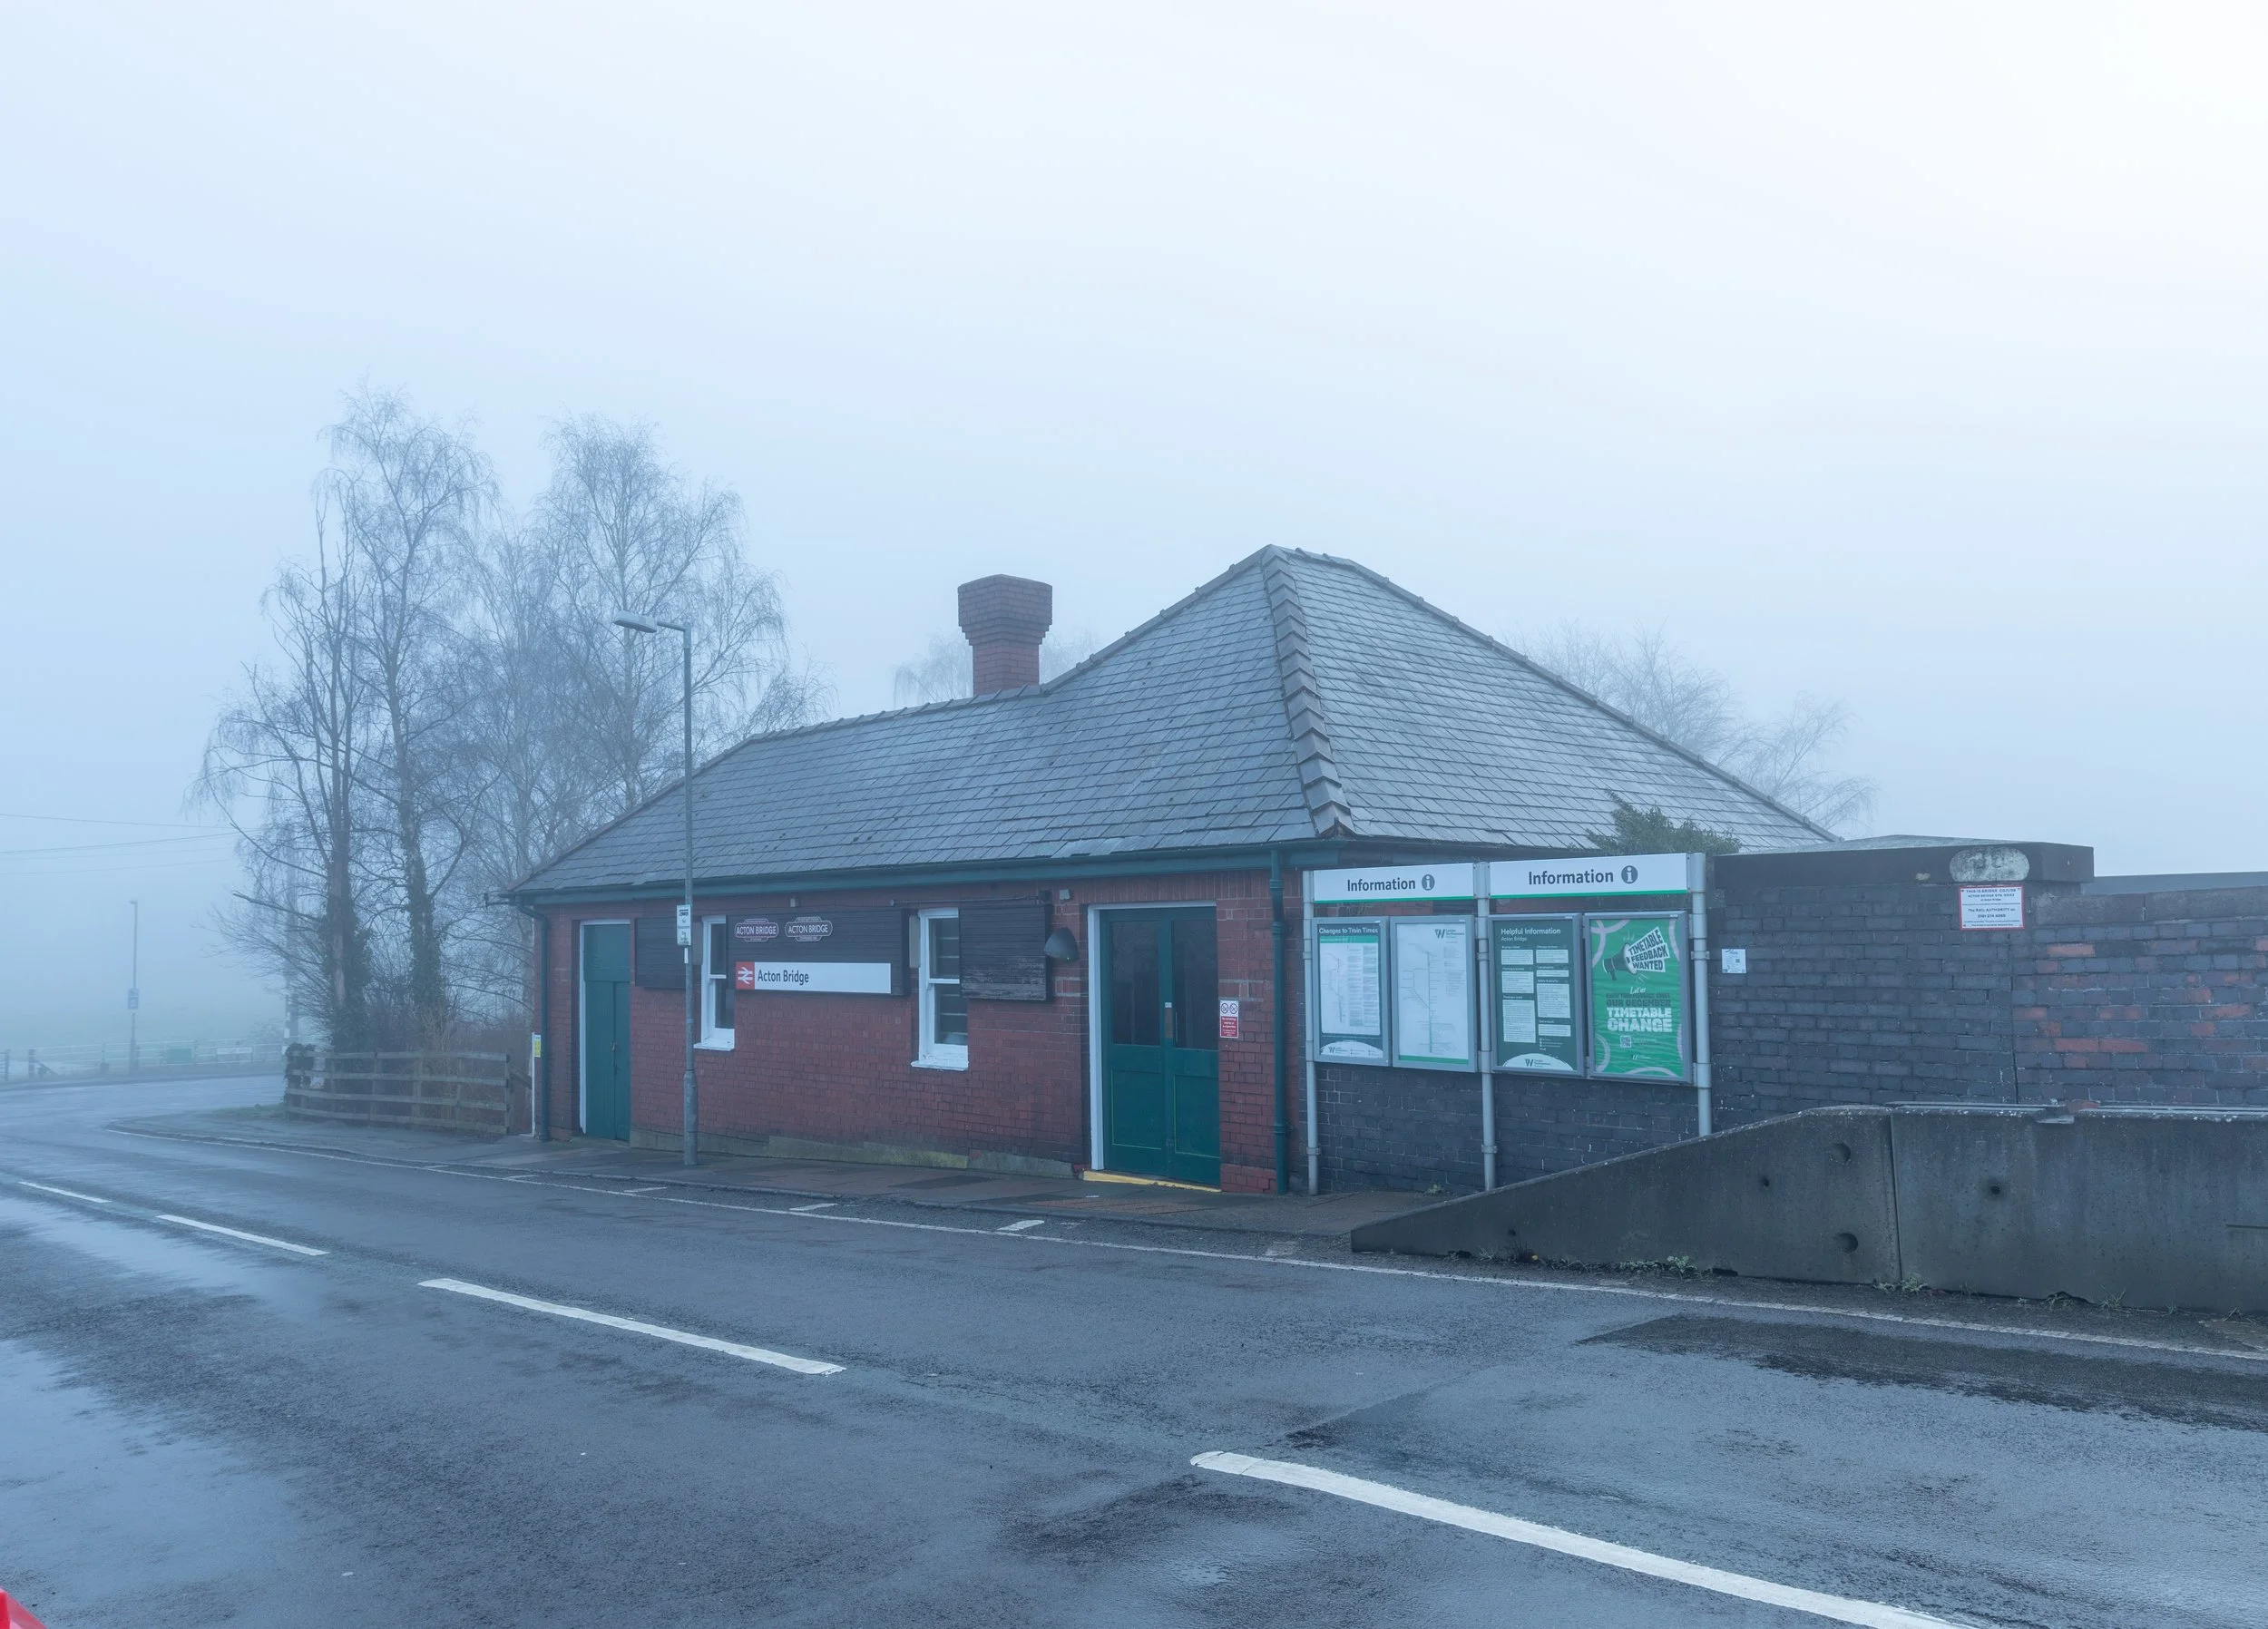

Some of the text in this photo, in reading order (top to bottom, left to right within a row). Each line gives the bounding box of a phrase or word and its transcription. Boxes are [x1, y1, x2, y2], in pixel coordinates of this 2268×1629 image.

[1529, 869, 1614, 885] Information
[1347, 878, 1416, 892] Information
[736, 926, 776, 935] ACTON BRIDGE
[788, 924, 828, 933] ACTON BRIDGE
[1628, 929, 1663, 955] TIMETABLE
[1631, 945, 1668, 962] FEEDBACK
[1633, 960, 1663, 971] WANTED
[757, 969, 809, 985] Acton Bridge
[1606, 1007, 1672, 1018] TIMETABLE
[1607, 1018, 1672, 1032] CHANGE
